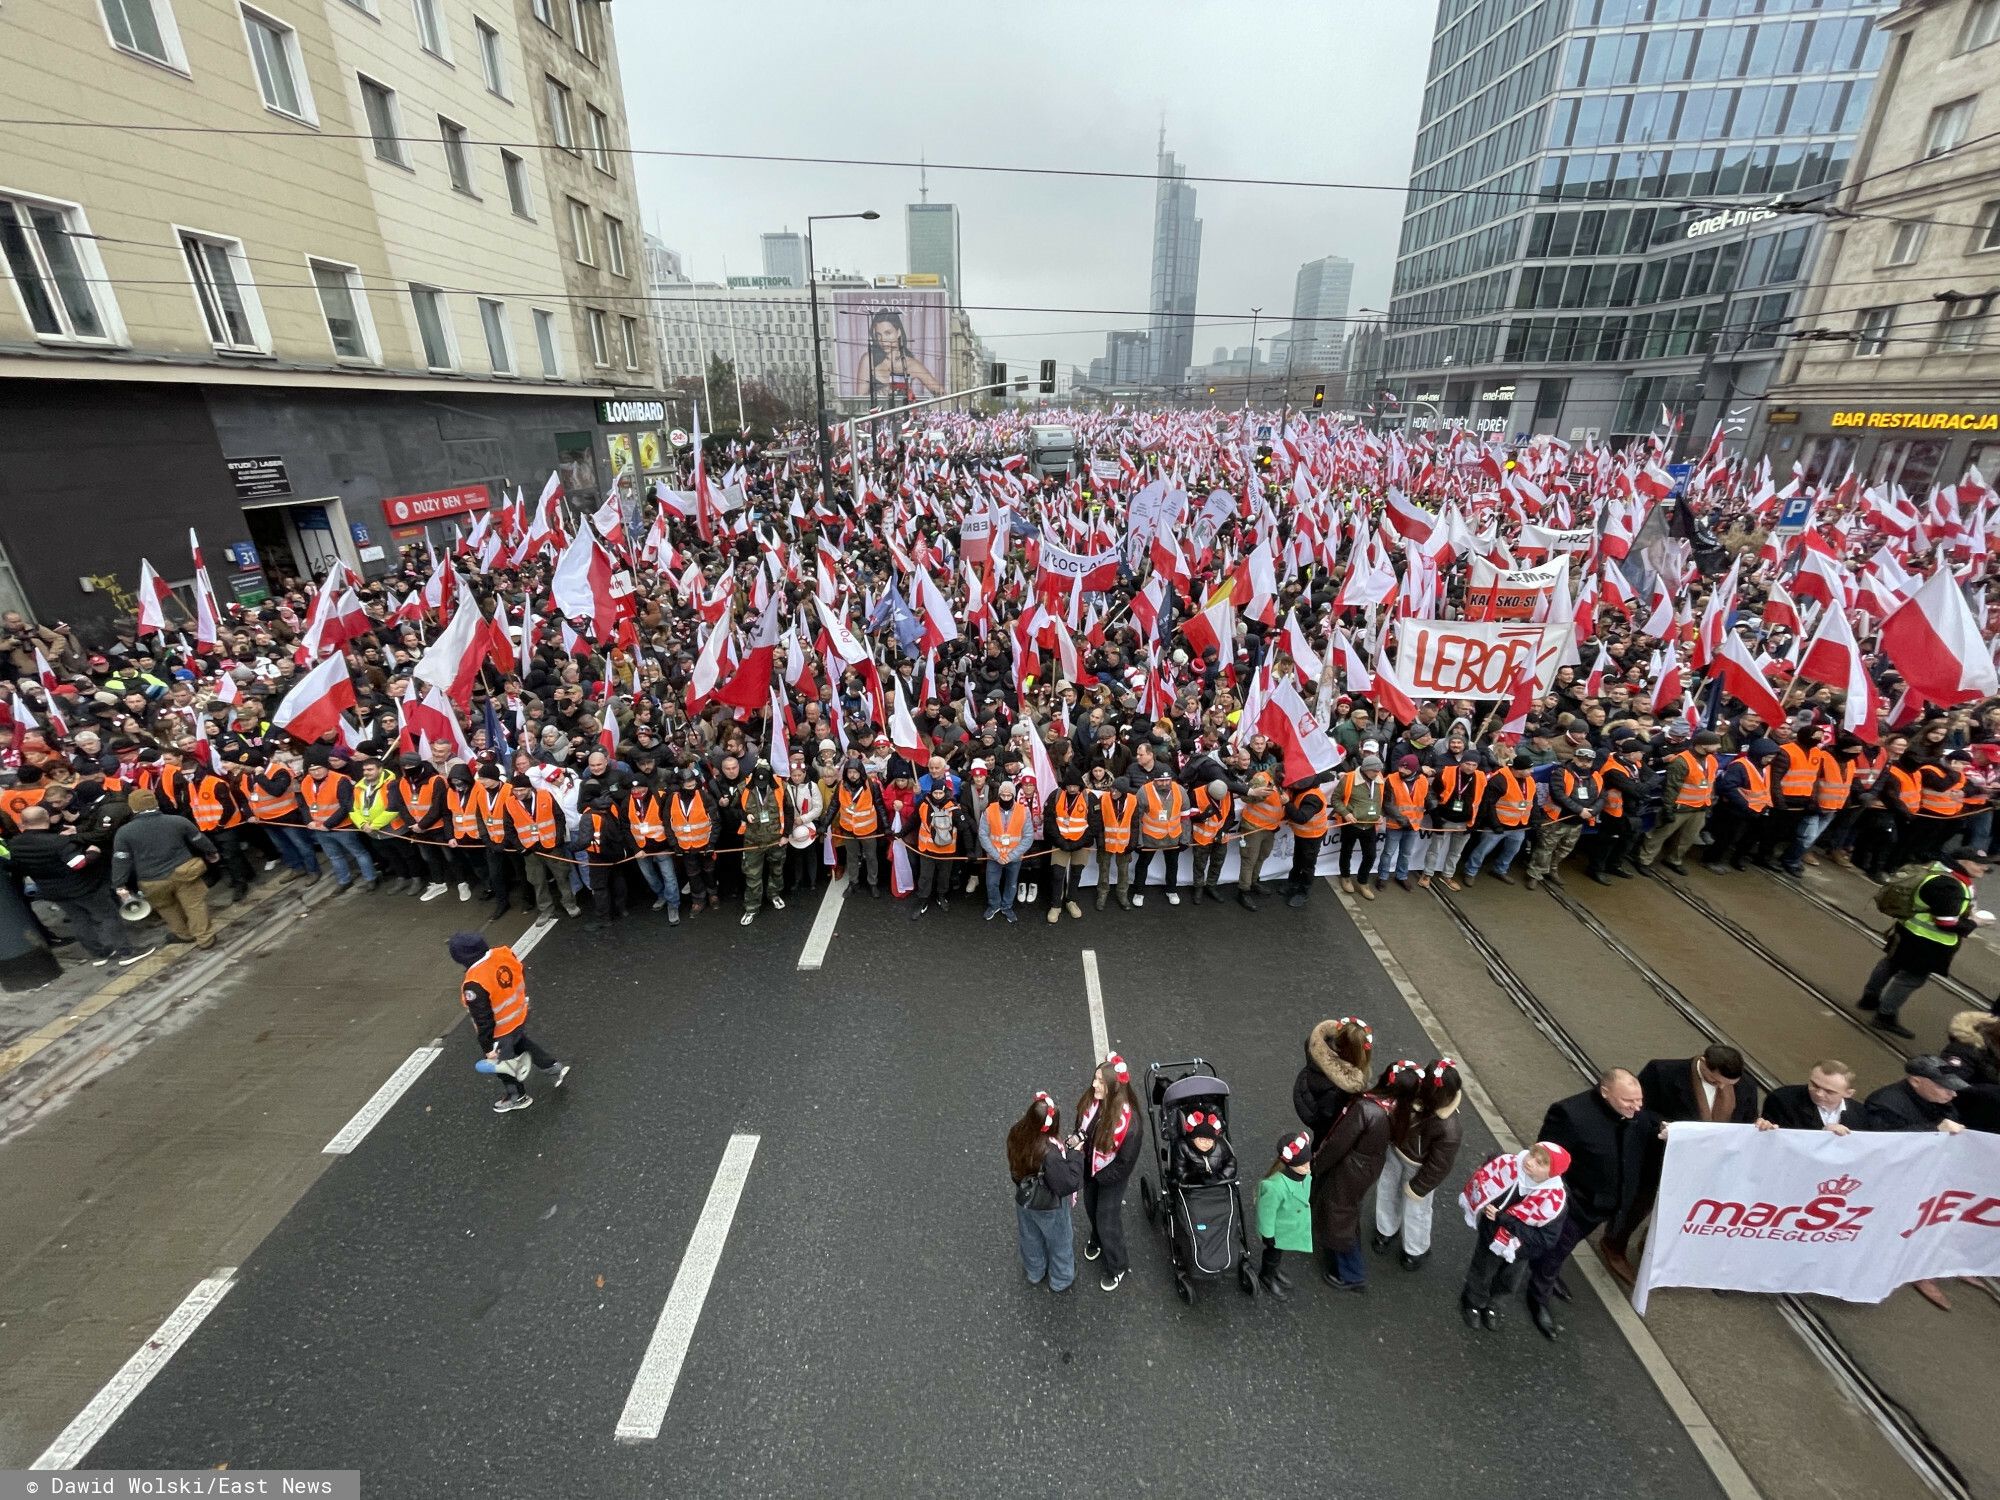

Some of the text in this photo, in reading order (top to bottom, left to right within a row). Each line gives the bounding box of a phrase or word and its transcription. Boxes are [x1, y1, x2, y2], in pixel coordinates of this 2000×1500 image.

[727, 276, 792, 287] HOTEL METROPOL
[606, 402, 664, 423] LOOMBARD
[1831, 412, 1999, 430] BAR RESTAURACJA
[412, 497, 440, 515] DUŻY
[442, 495, 461, 509] BEN
[1787, 500, 1806, 518] P
[357, 530, 368, 541] 33
[241, 552, 255, 564] 31
[1470, 594, 1537, 607] KASKO-SI
